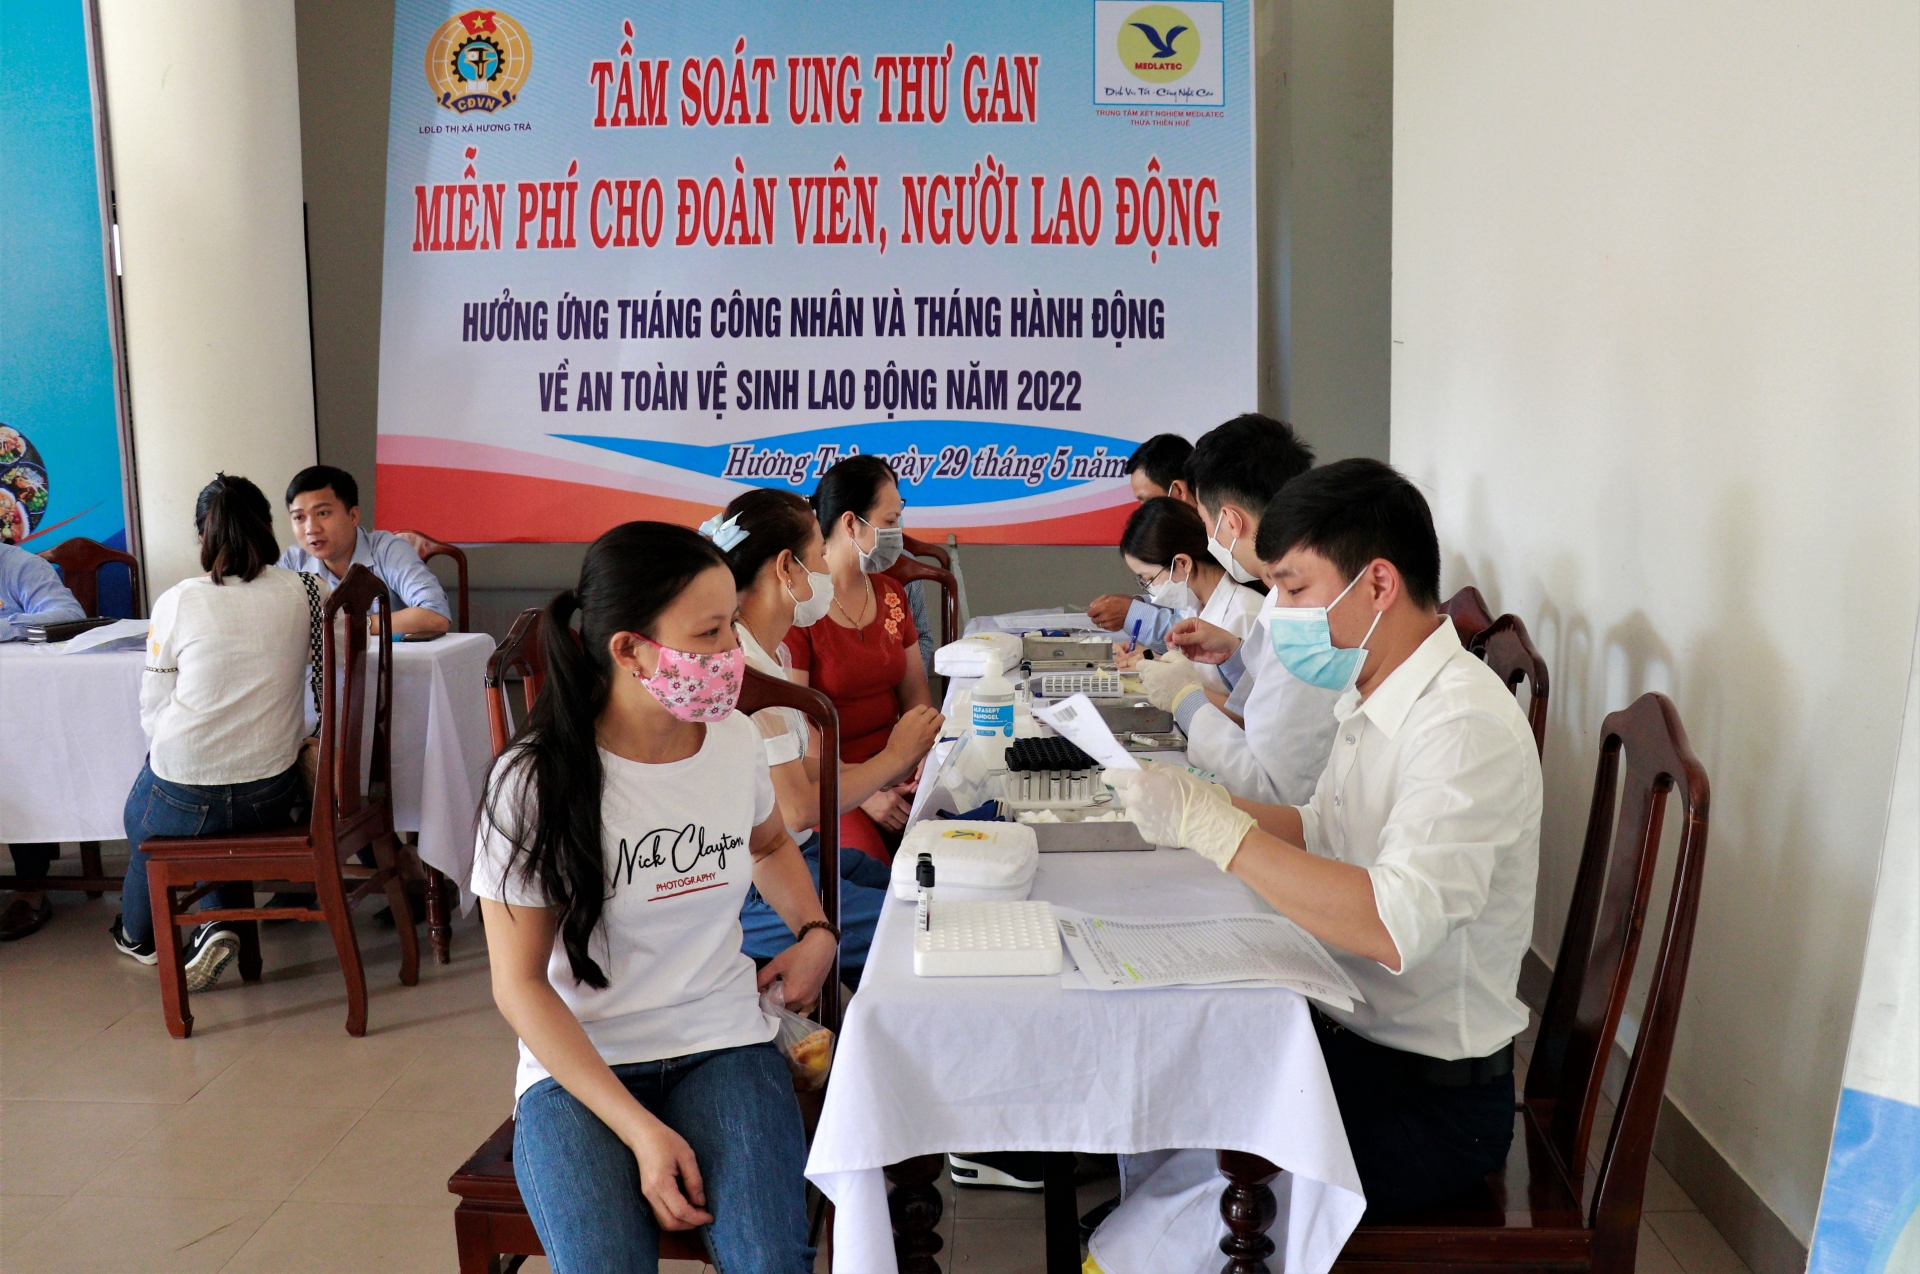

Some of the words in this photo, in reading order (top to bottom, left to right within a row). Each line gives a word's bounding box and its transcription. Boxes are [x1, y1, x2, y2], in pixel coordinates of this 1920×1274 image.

[589, 19, 670, 127] TẦM
[680, 37, 776, 126] SOÁT
[787, 55, 862, 124] UNG
[874, 43, 953, 124] THƯ
[963, 55, 1039, 124] GAN
[1135, 62, 1183, 70] MEDLATEC
[457, 97, 495, 111] CĐVN
[1156, 110, 1184, 118] NGHIỆM
[419, 126, 443, 134] LĐLĐ
[445, 125, 459, 134] THỊ
[462, 122, 474, 132] XÃ
[476, 123, 511, 132] HƯƠNG
[514, 121, 532, 131] TRÀ
[412, 147, 506, 252] MIỄN
[516, 160, 579, 249] PHÍ
[590, 178, 663, 249] CHO
[675, 156, 778, 247] ĐOÀN
[788, 155, 887, 254] VIÊN,
[901, 154, 1019, 246] NGƯỜI
[1031, 175, 1101, 246] LAO
[1114, 156, 1220, 264] ĐỘNG
[462, 288, 548, 342] HƯỞNG
[556, 292, 609, 341] ỨNG
[617, 290, 702, 340] THÁNG
[710, 289, 781, 339] CÔNG
[790, 288, 864, 338] NHÂN
[872, 288, 906, 337] VÀ
[914, 288, 1001, 337] THÁNG
[1010, 288, 1084, 338] HÀNH
[1091, 289, 1166, 348] ĐỘNG
[539, 358, 569, 412] VỀ
[576, 372, 613, 412] AN
[621, 362, 689, 411] TOÀN
[697, 361, 728, 420] VỆ
[736, 370, 799, 411] SINH
[808, 369, 856, 410] LAO
[864, 360, 937, 420] ĐỘNG
[946, 360, 1009, 411] NĂM
[1017, 370, 1082, 411] 2022
[725, 446, 811, 483] Hương
[936, 447, 969, 477] 29
[972, 447, 1048, 484] tháng
[1051, 448, 1070, 478] 5
[1071, 449, 1128, 478] năm
[612, 828, 672, 888] Nick
[672, 823, 744, 874] Clayton
[656, 872, 716, 892] PHOTOGRAPHY
